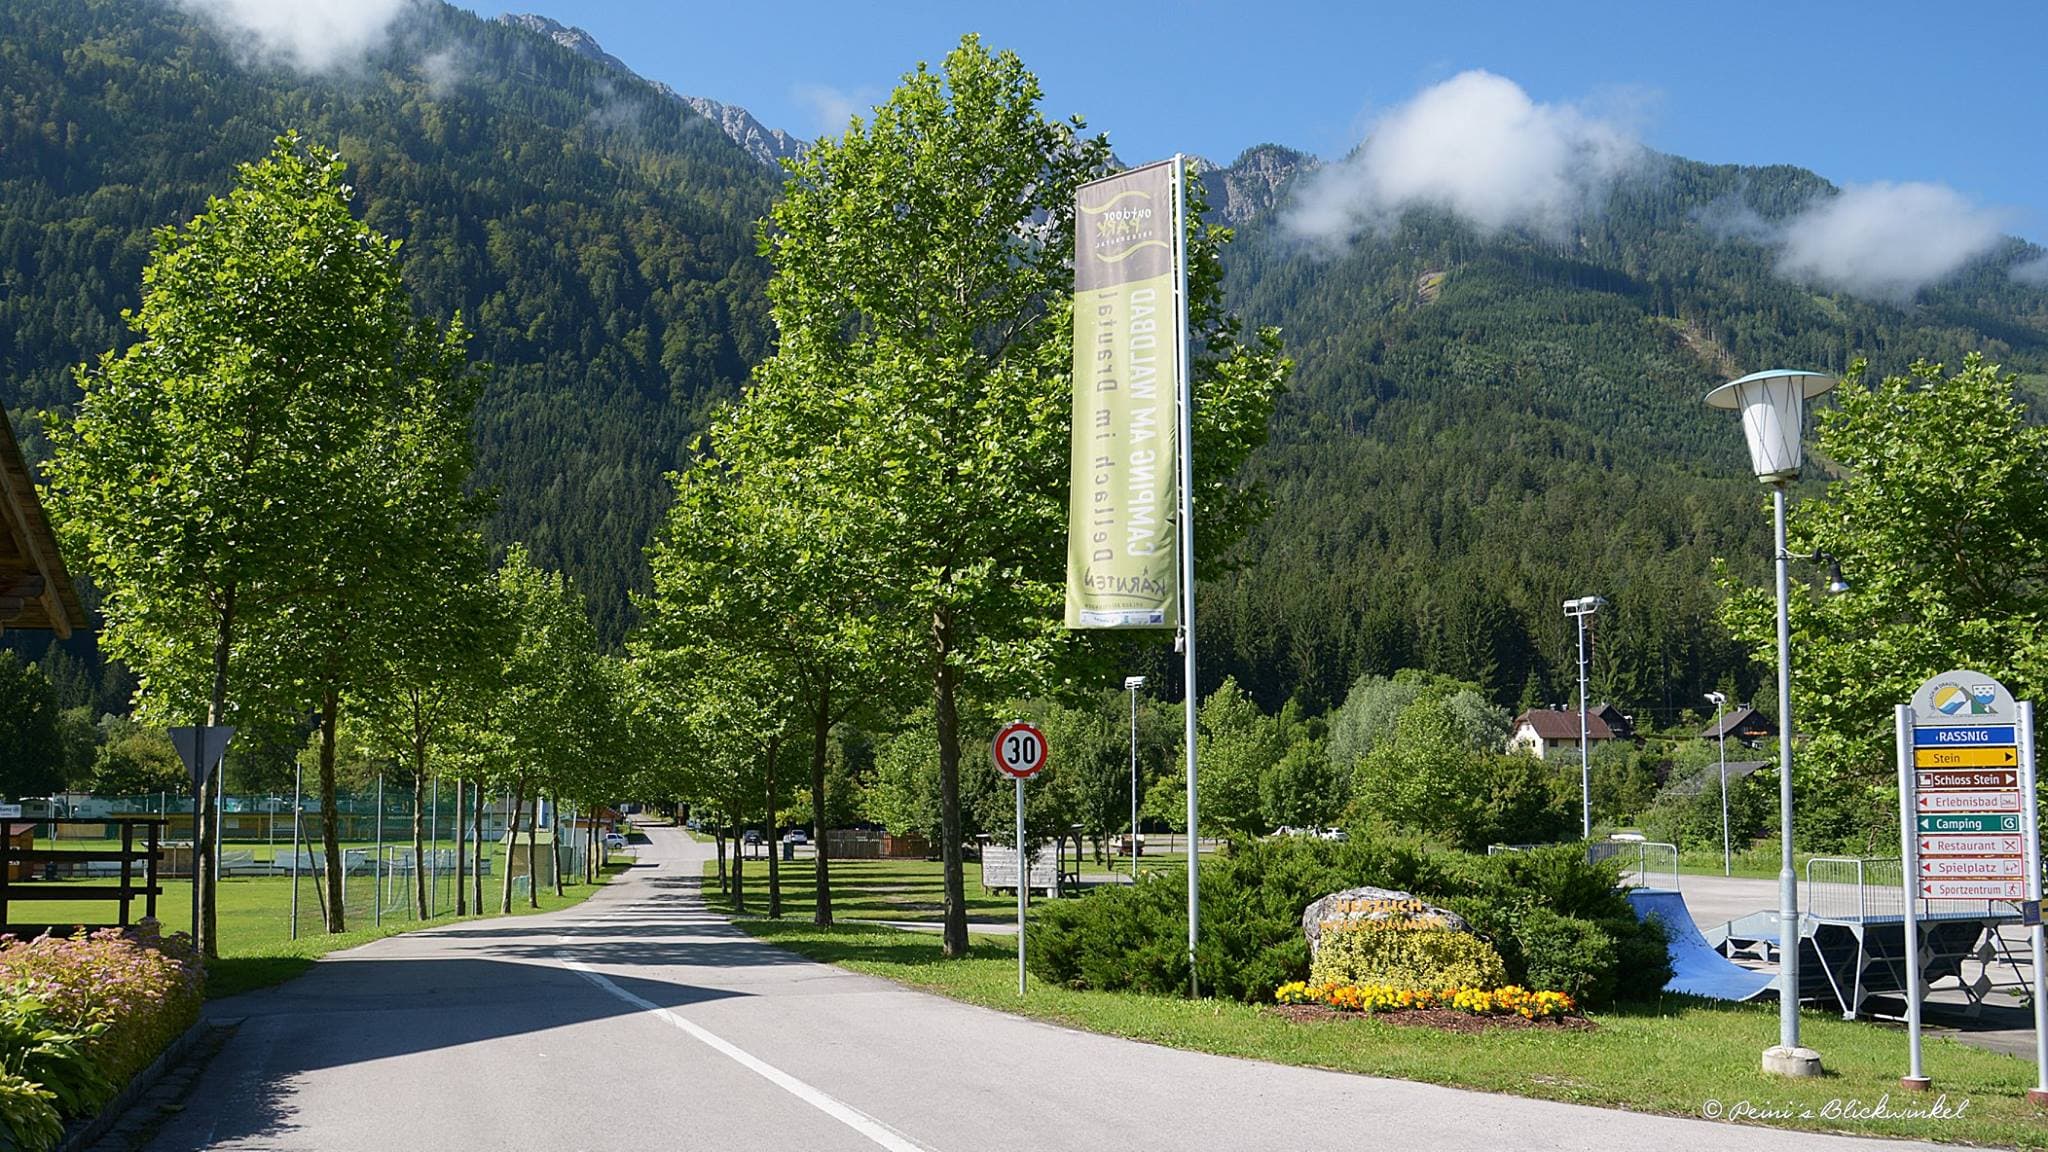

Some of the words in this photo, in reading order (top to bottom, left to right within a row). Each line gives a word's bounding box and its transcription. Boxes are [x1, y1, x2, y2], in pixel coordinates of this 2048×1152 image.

[1939, 731, 1988, 741] RASSNIG
[1008, 736, 1035, 764] 30
[1934, 753, 1960, 764] Stein
[1934, 774, 1971, 785] Schloss
[1974, 774, 2000, 785] Stein
[1936, 797, 1998, 807] Erlebnisbad
[1936, 818, 1982, 830] Camping
[1938, 841, 1996, 851] Restaurant
[1939, 863, 1997, 874] Spielplatz
[1940, 885, 2000, 895] Sportzentrum
[1336, 899, 1422, 913] HERZLICH
